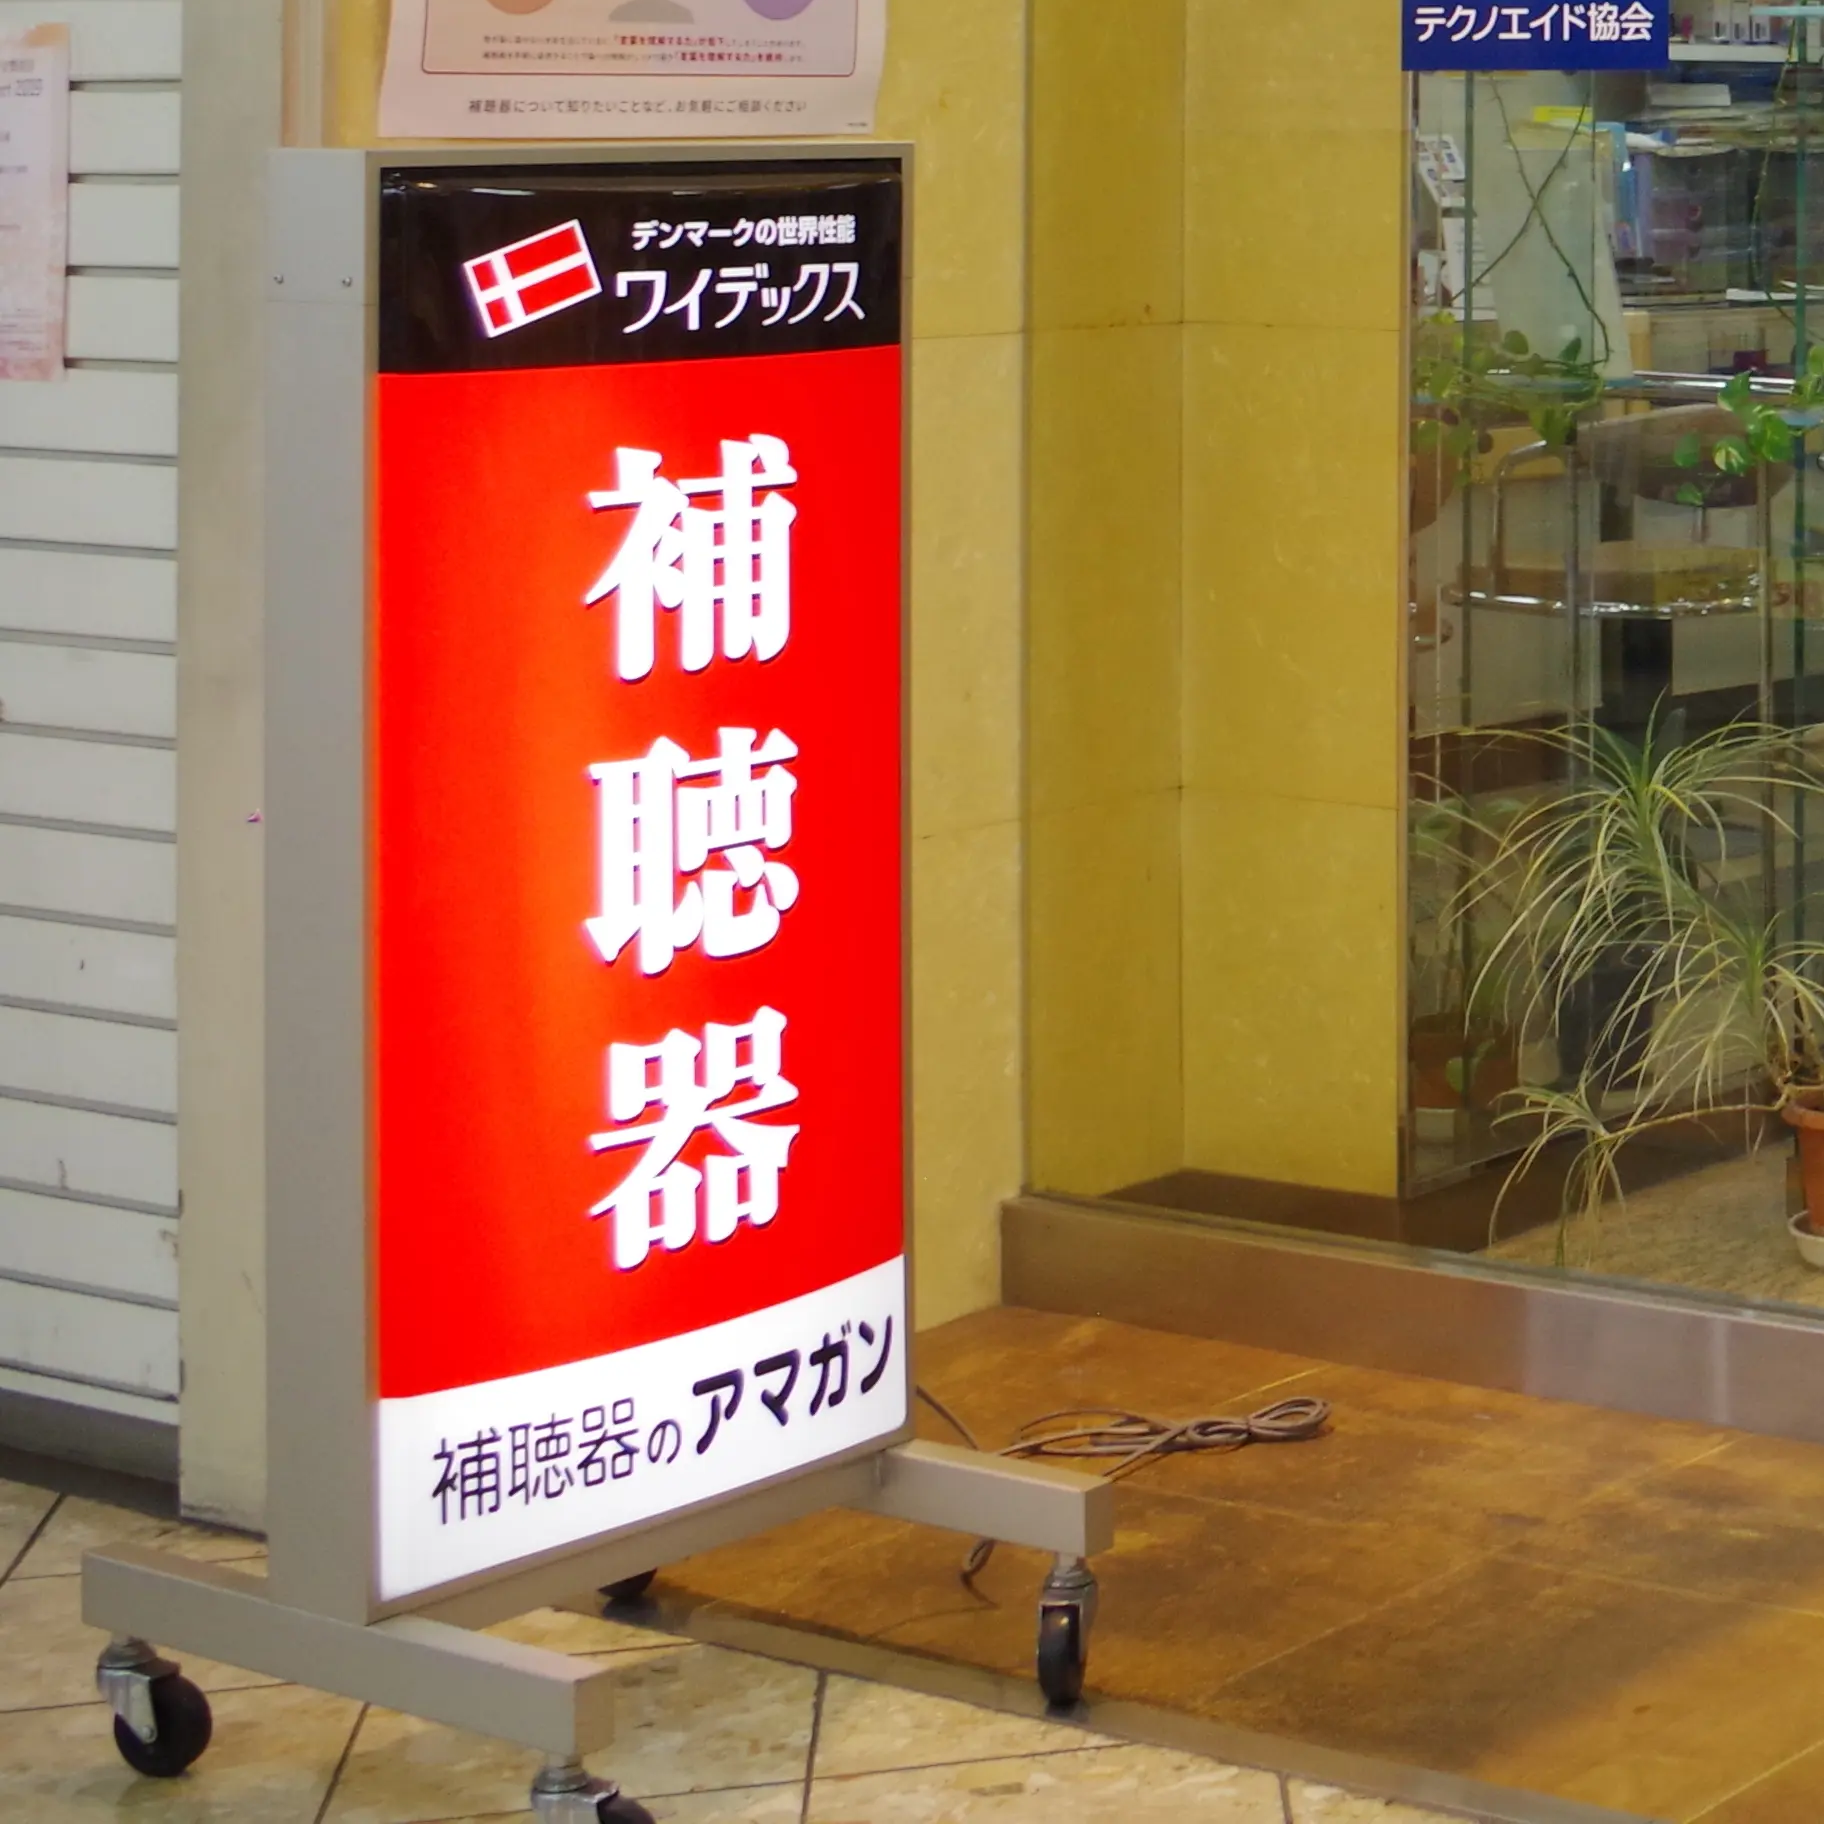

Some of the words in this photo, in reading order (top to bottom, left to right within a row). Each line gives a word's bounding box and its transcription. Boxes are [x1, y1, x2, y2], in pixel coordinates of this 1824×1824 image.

[1415, 1, 1655, 42] テクノエイド協会
[632, 214, 855, 250] デンマークの世界性能
[616, 262, 865, 333] ワイデックス
[586, 434, 800, 1271] 補聴器
[432, 1314, 893, 1525] 補聴器のアマガン
